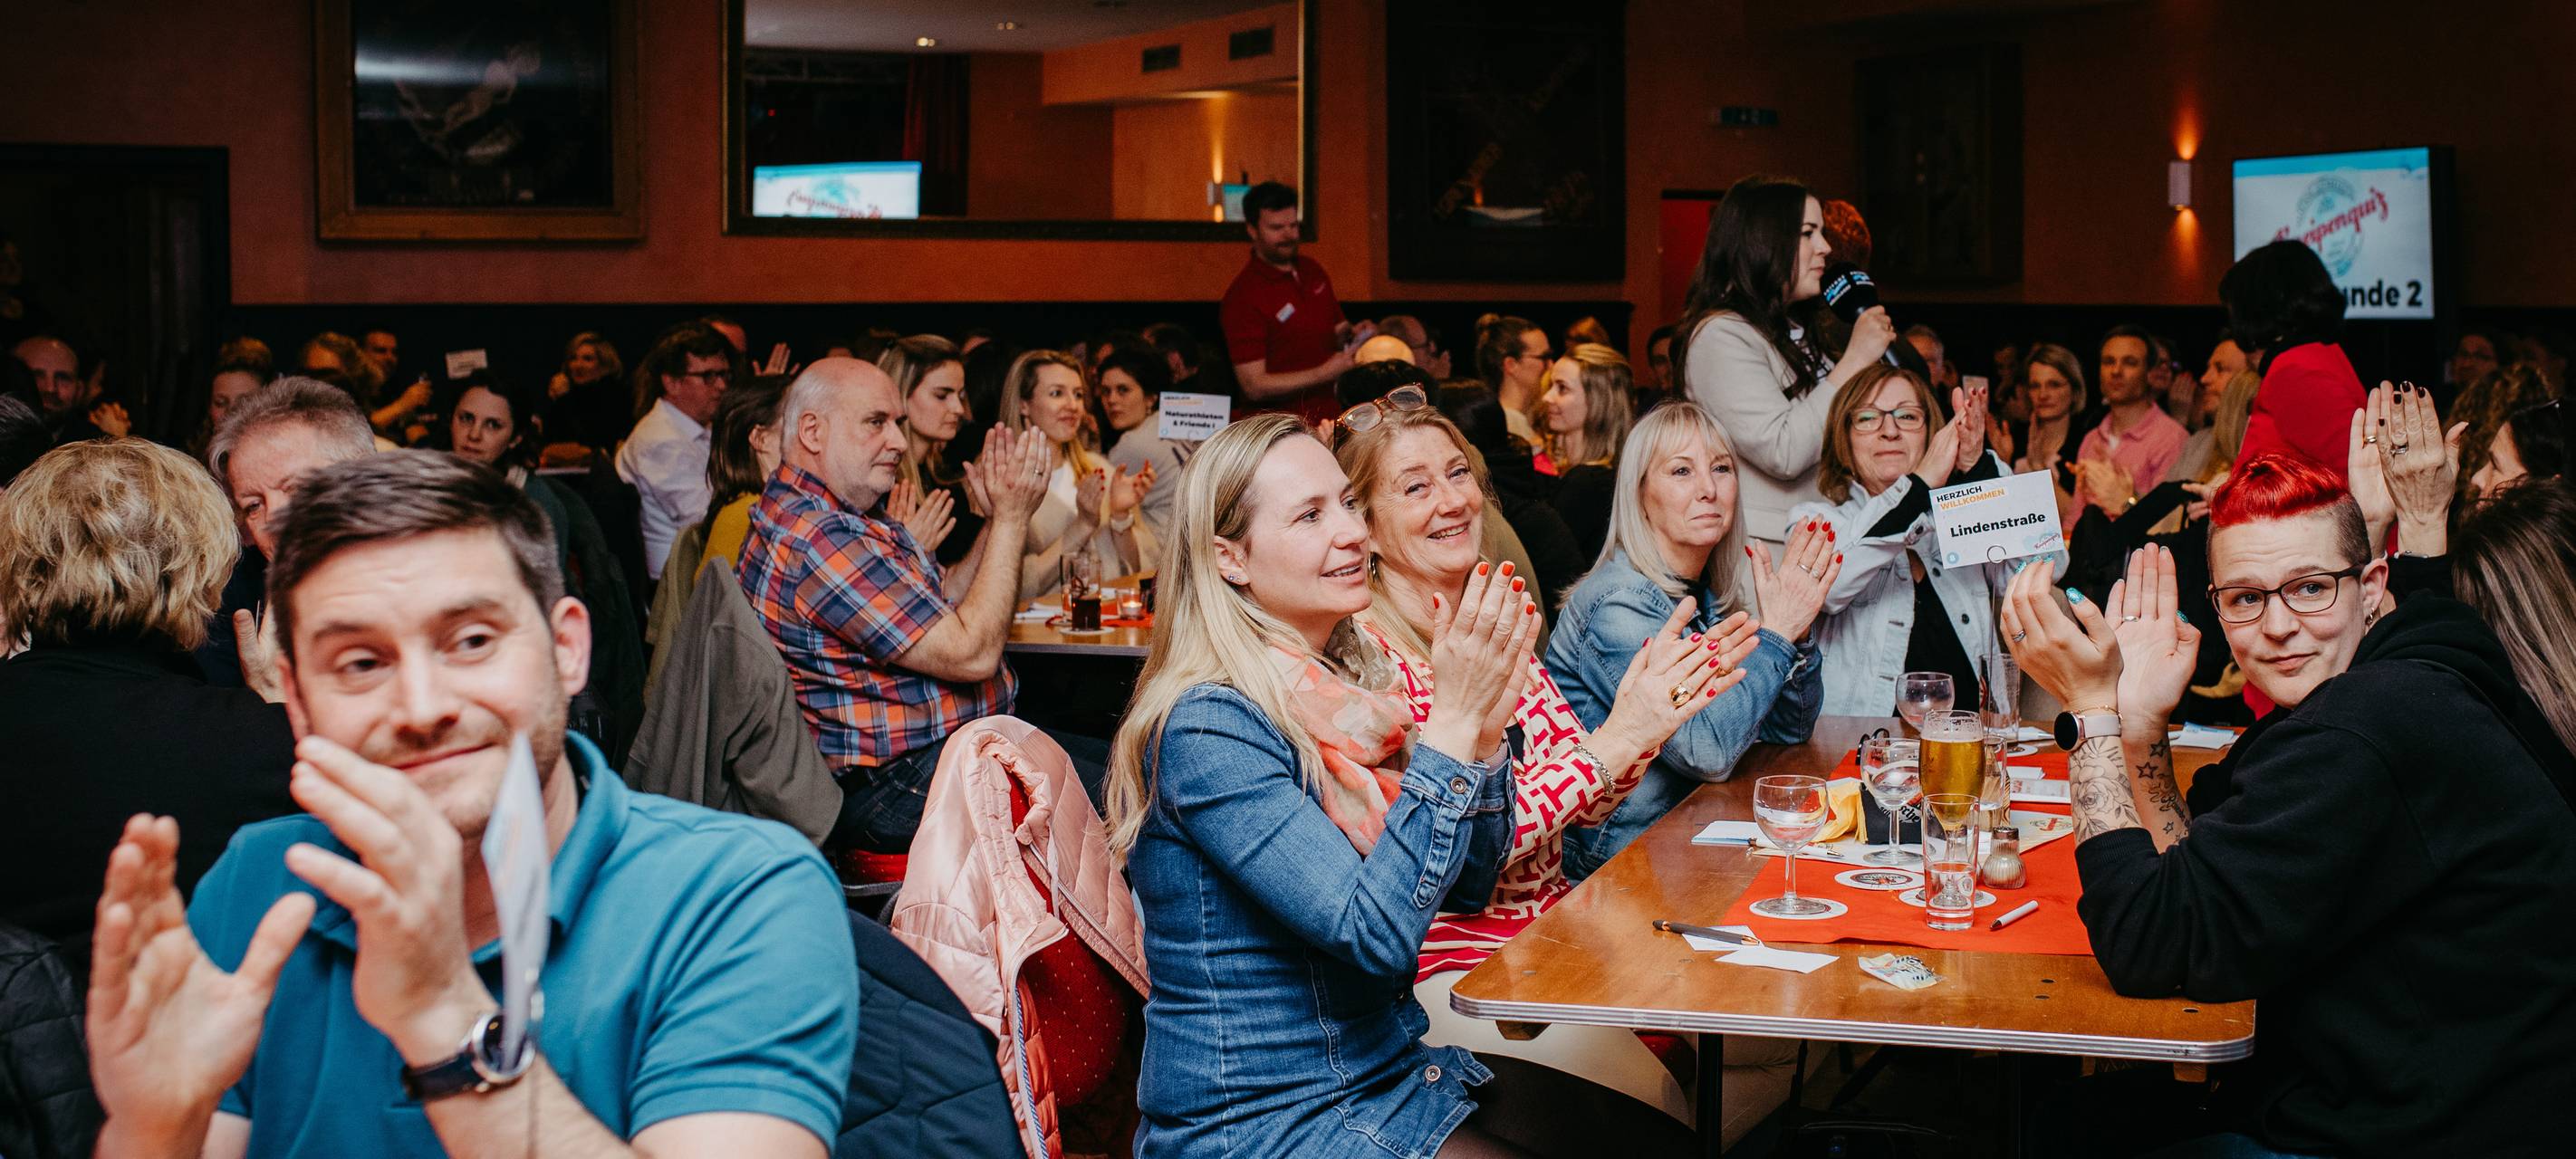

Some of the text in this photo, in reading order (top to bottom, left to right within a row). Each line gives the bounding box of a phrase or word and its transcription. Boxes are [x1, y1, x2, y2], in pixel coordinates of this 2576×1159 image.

[2407, 280, 2423, 307] 2
[1937, 485, 1983, 503] HERZLICH
[1940, 488, 2005, 510] WILLKOMMEN
[1950, 512, 2046, 538] Lindenstraße
